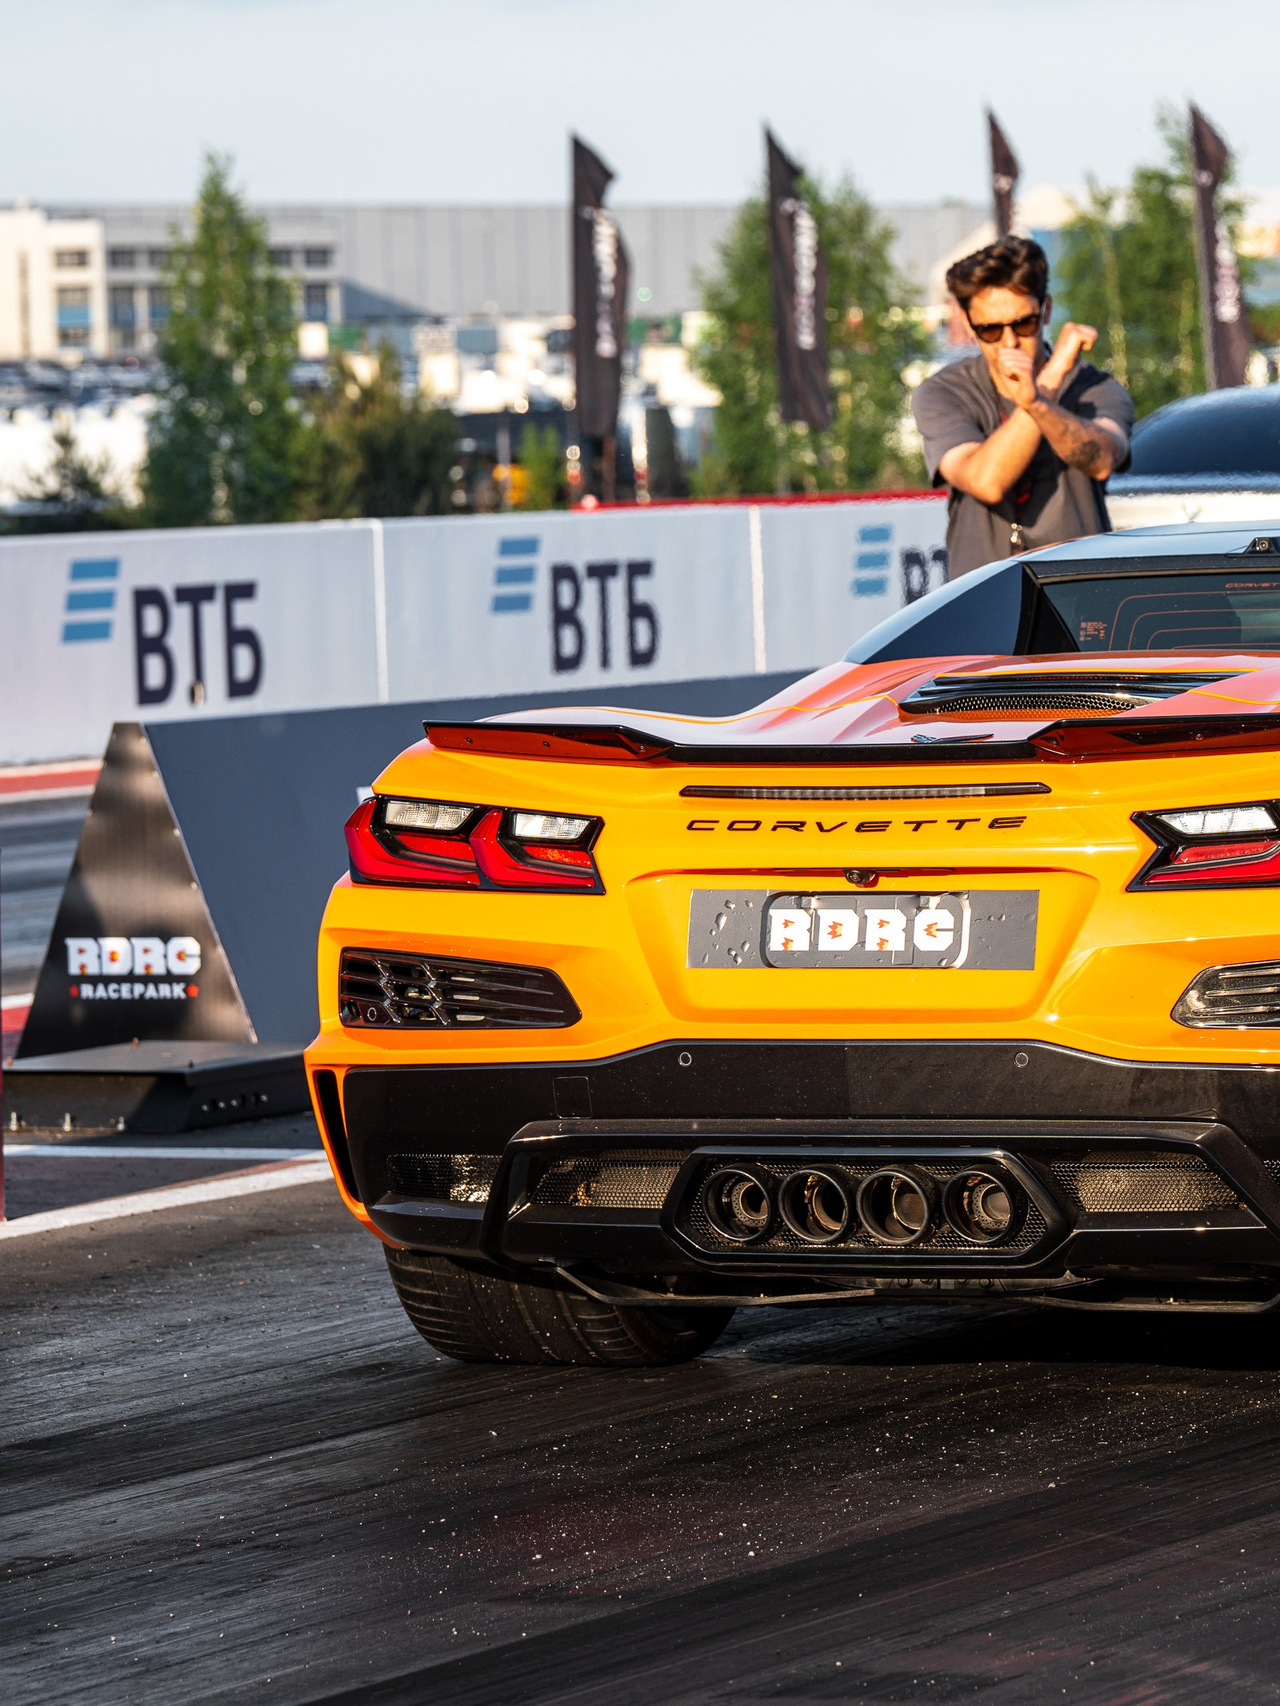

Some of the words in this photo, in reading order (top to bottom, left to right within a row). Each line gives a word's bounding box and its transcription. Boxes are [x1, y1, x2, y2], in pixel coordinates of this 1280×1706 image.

[550, 560, 660, 675] ВТБ
[133, 581, 265, 706] ВТБ
[686, 815, 1027, 833] CORVETTE
[769, 908, 955, 951] RDRC
[64, 937, 202, 976] RDRC
[79, 982, 188, 1000] RACEPARK
